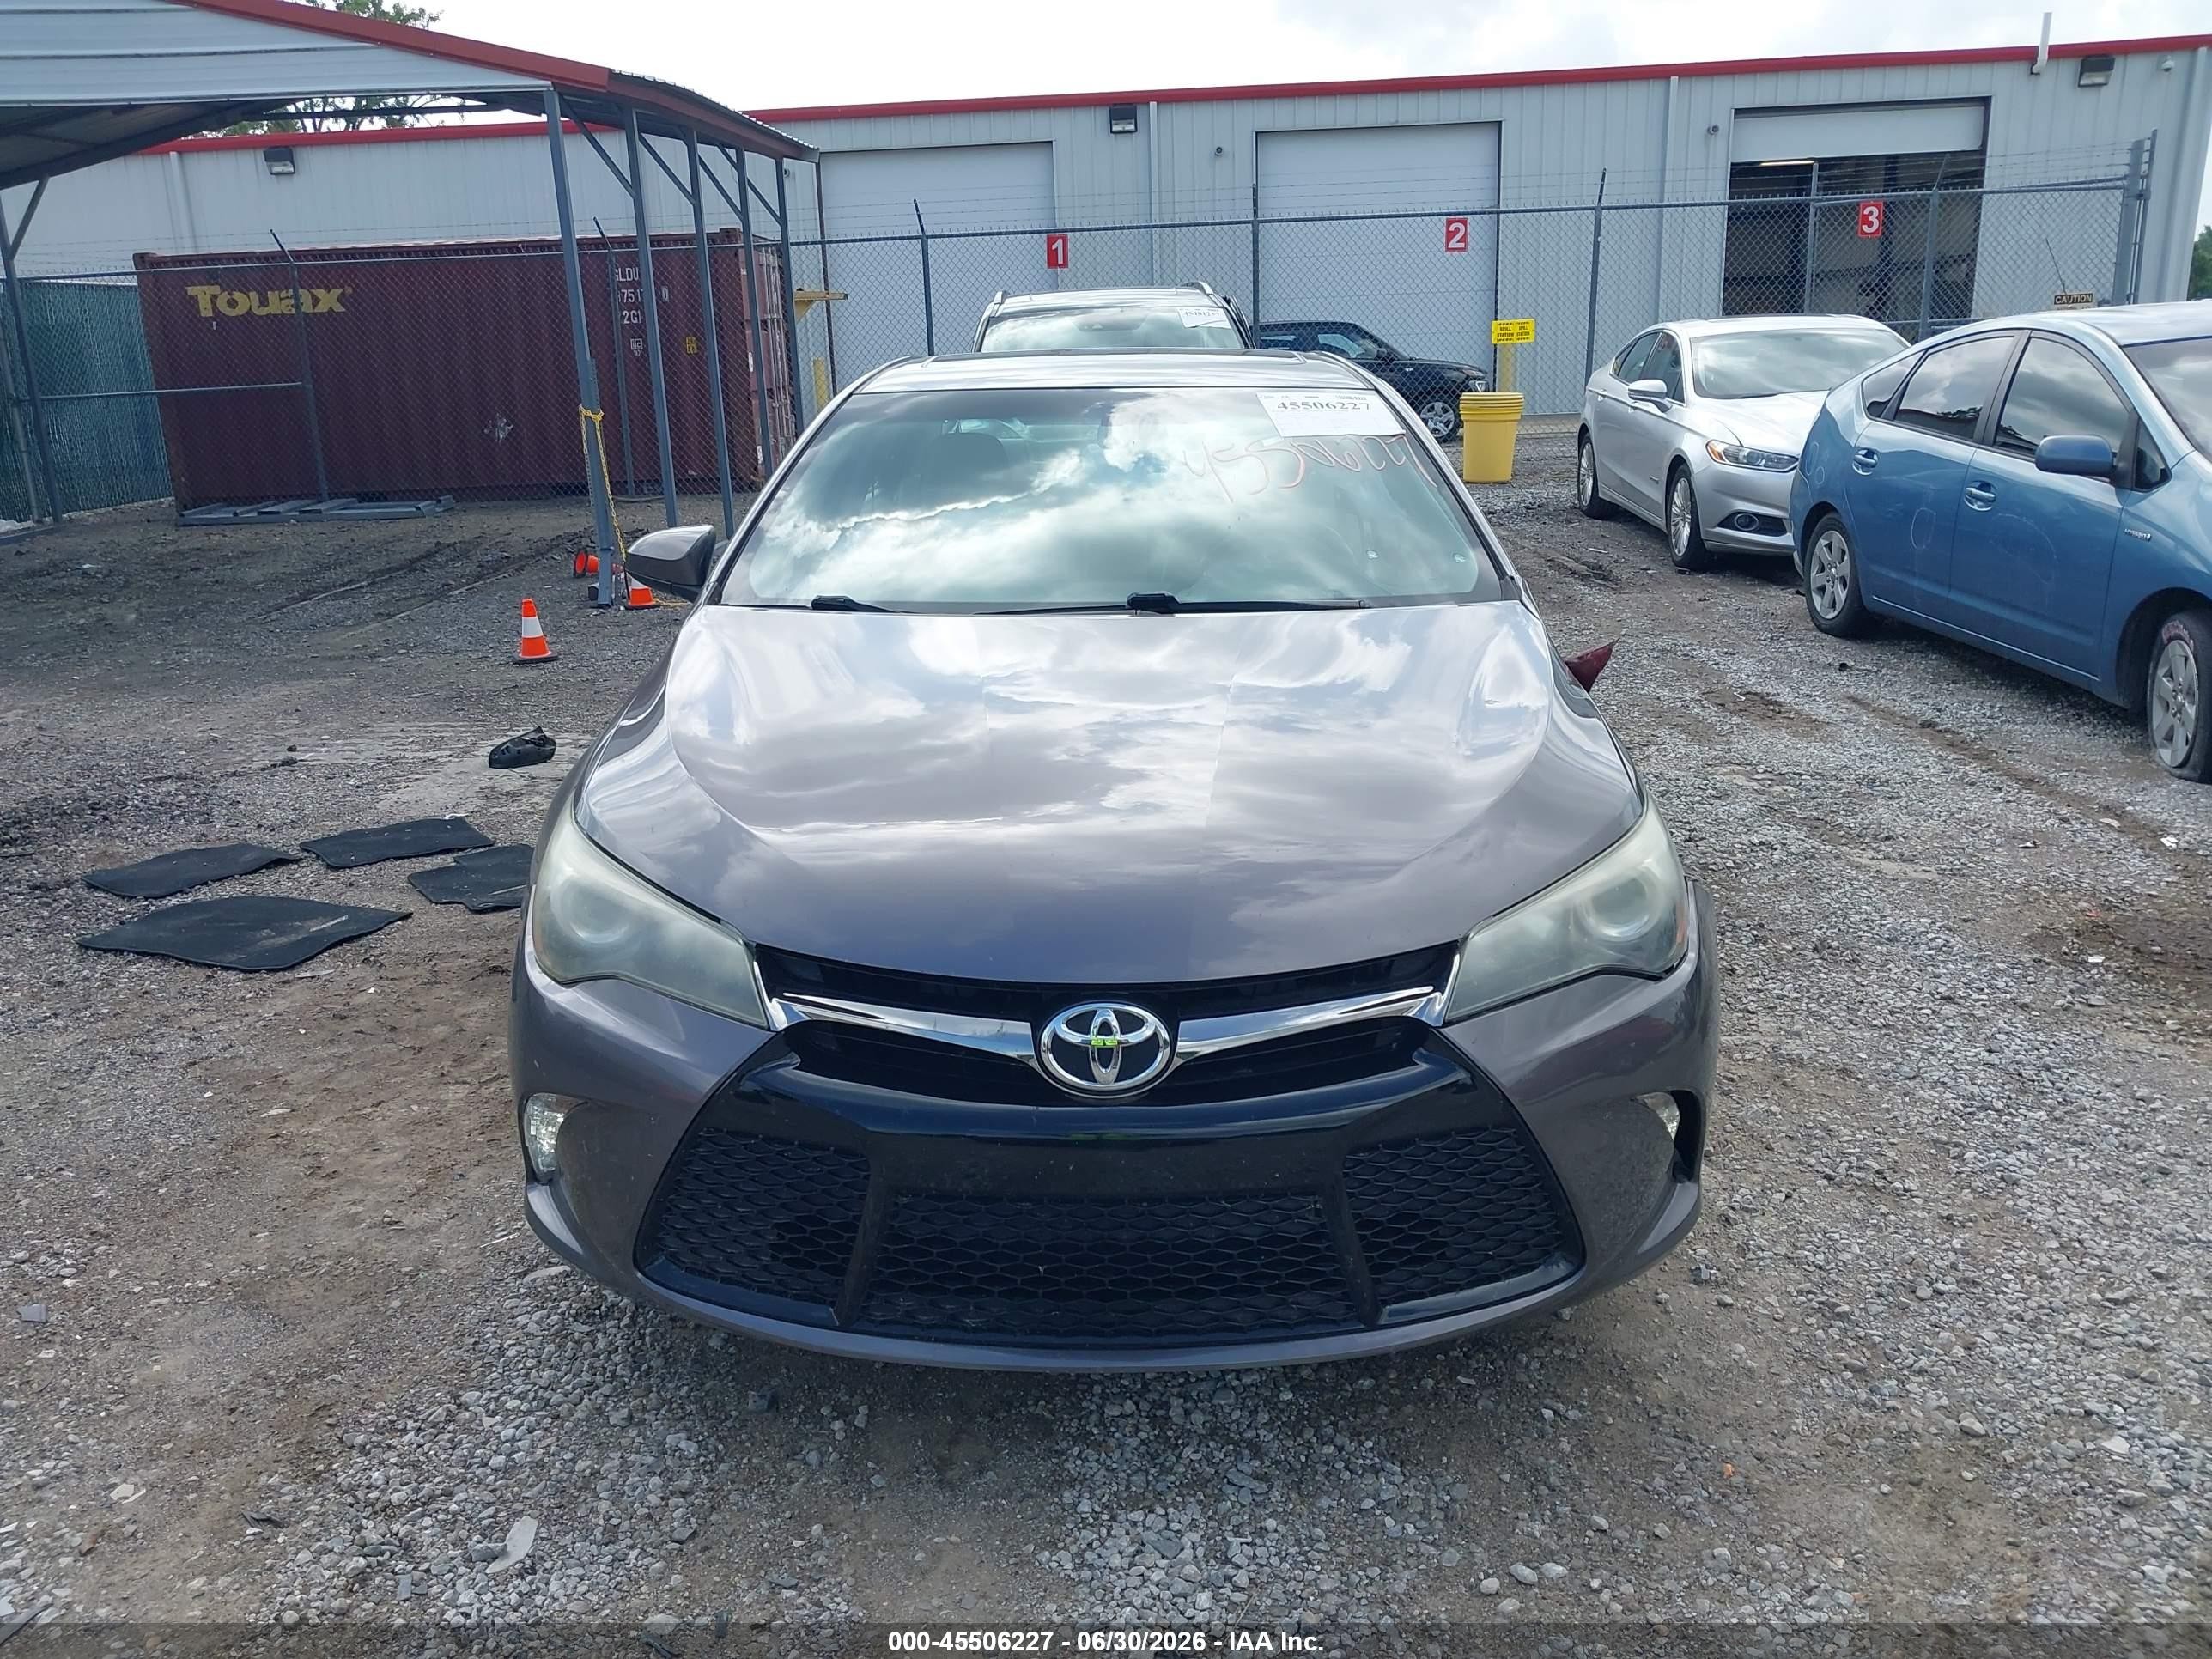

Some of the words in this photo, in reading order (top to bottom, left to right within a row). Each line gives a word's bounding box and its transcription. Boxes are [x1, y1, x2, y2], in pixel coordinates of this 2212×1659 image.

[1862, 206, 1880, 233] 3
[1448, 222, 1466, 248] 2
[1052, 239, 1064, 264] 1
[2055, 295, 2093, 304] CAUTION
[1277, 401, 1370, 410] 45506227
